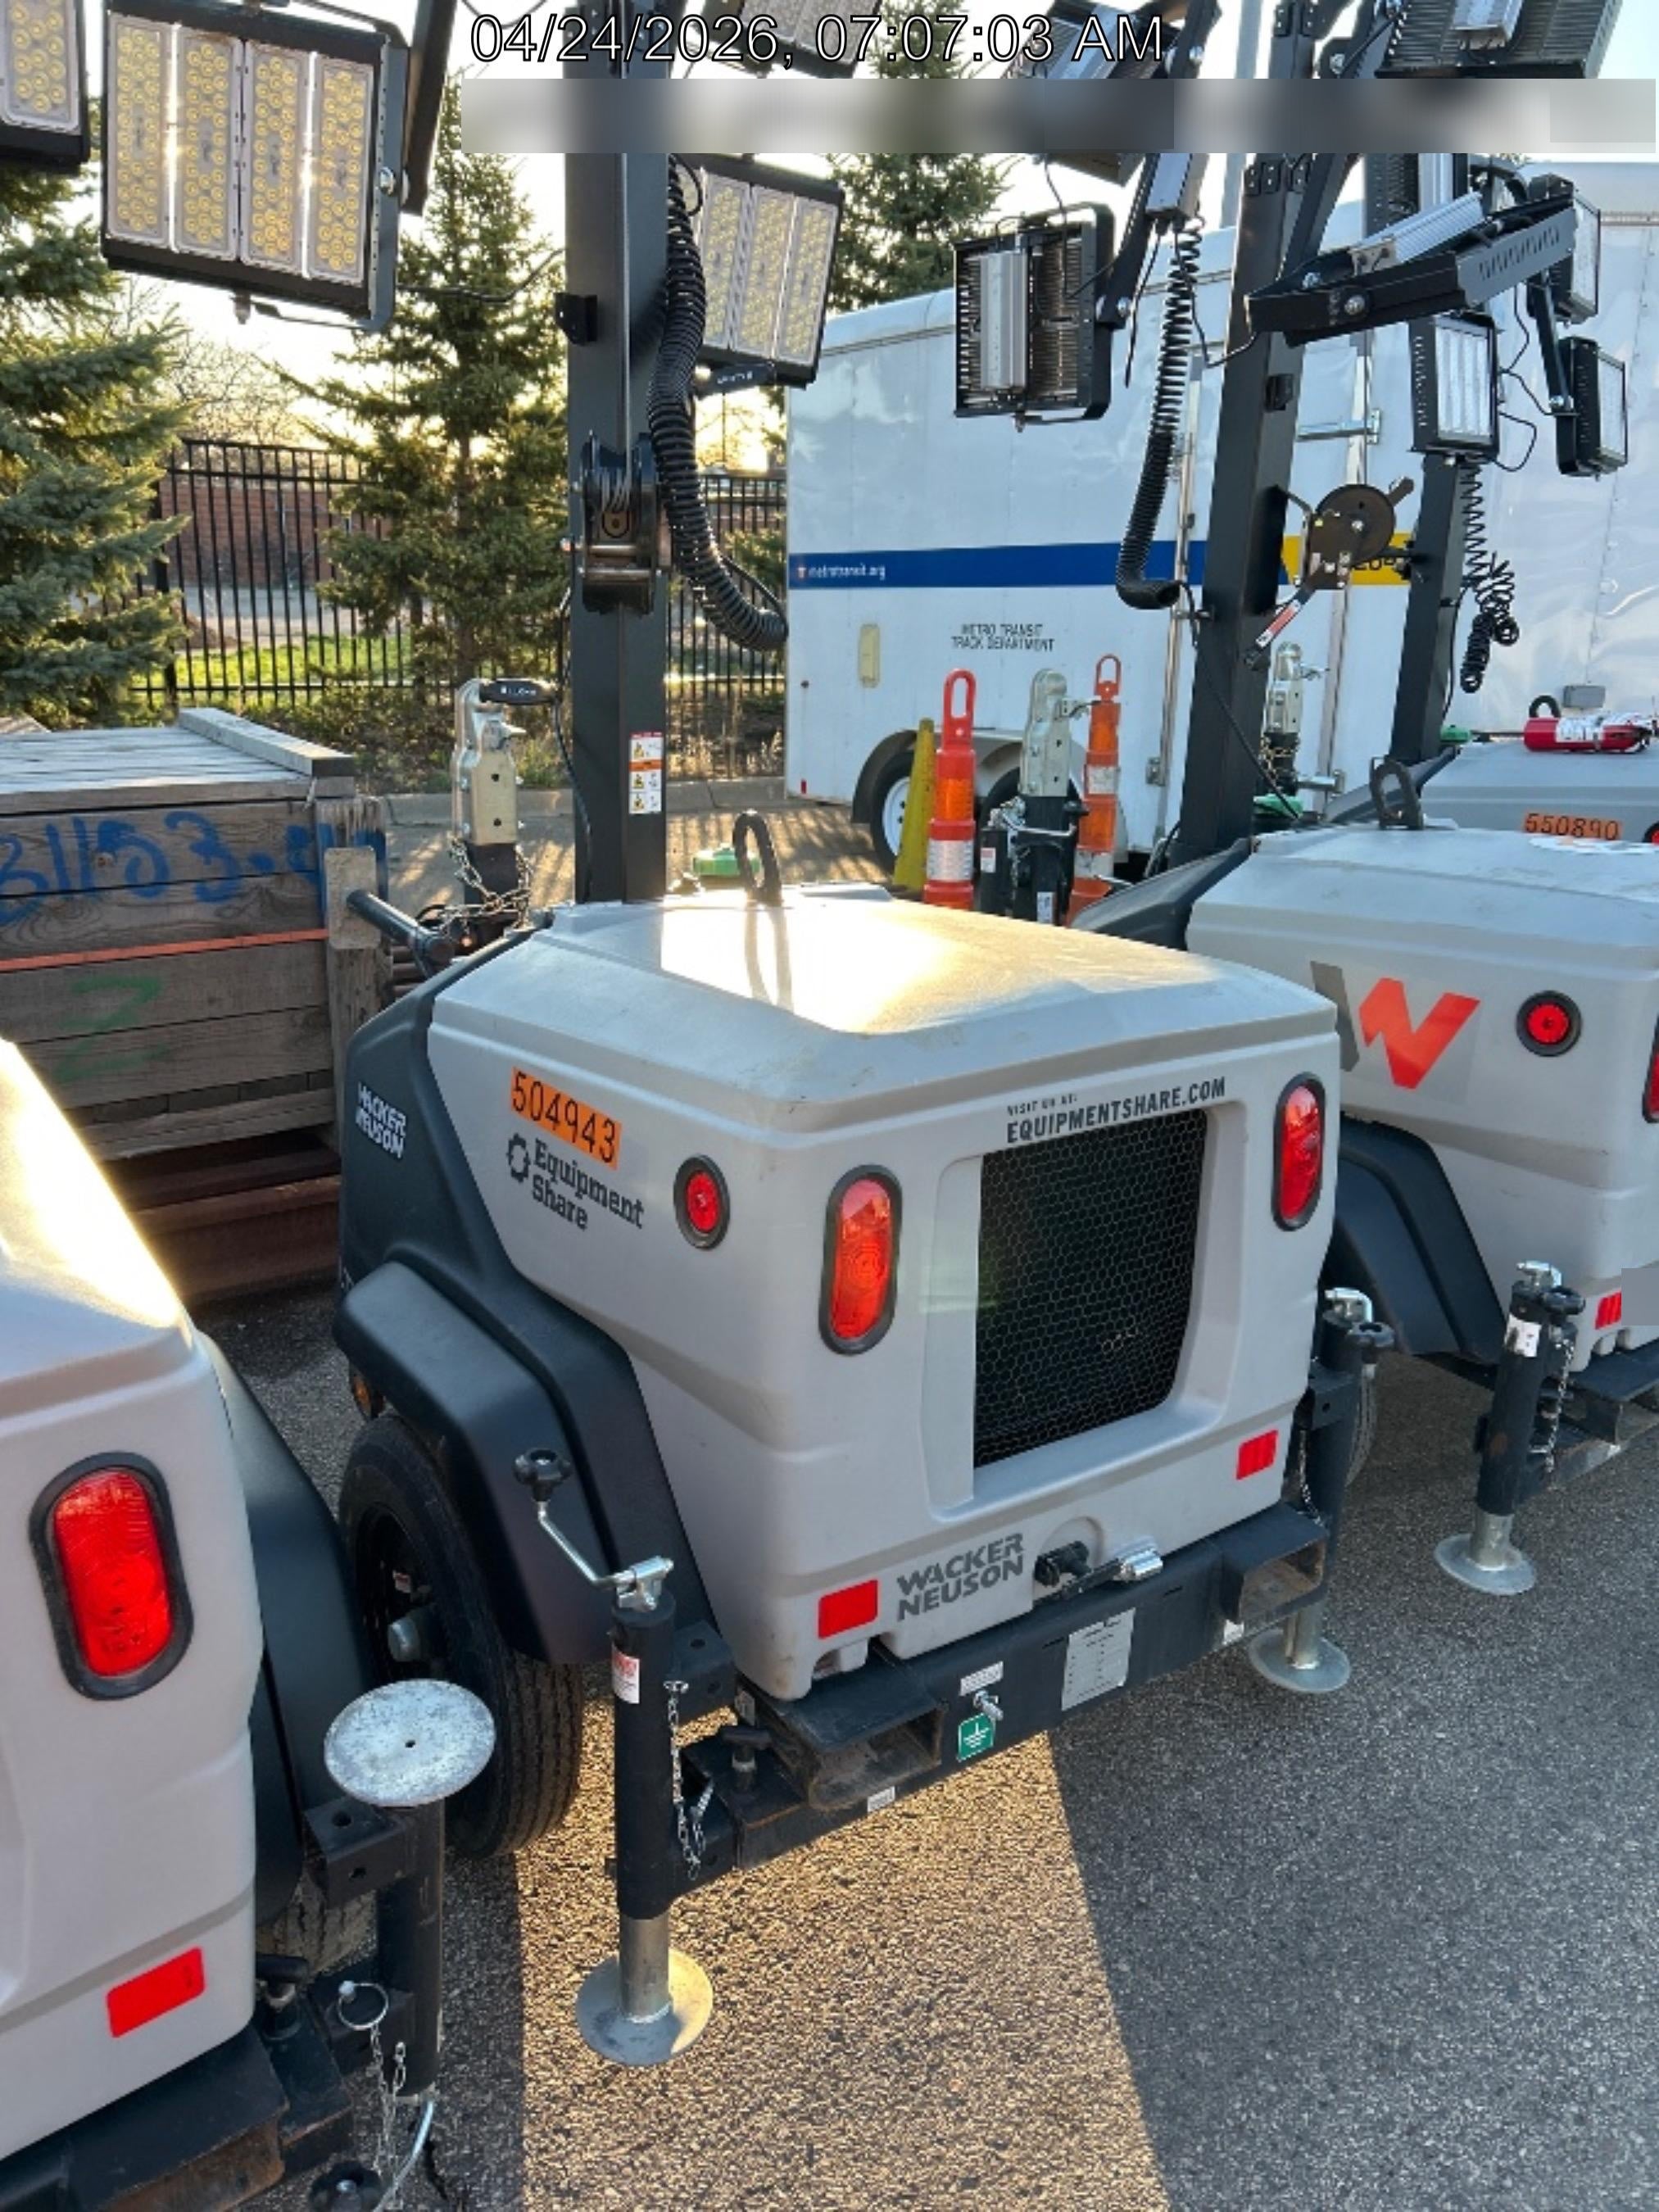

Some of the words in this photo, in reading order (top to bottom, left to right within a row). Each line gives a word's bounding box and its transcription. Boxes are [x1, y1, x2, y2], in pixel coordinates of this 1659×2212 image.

[951, 636, 984, 650] TRACK
[988, 637, 1055, 652] DEPARTMENT
[962, 623, 996, 636] METRO
[1000, 623, 1044, 637] TRANSIT
[513, 1071, 616, 1163] 504943
[1007, 1077, 1226, 1144] EQUIPMENTSHARE.COM
[1008, 1100, 1038, 1117] VISIT
[533, 1173, 588, 1231] Share
[534, 1137, 645, 1230] Equipment
[897, 1533, 1024, 1596] WACKER
[898, 1554, 1023, 1622] NEUSON
